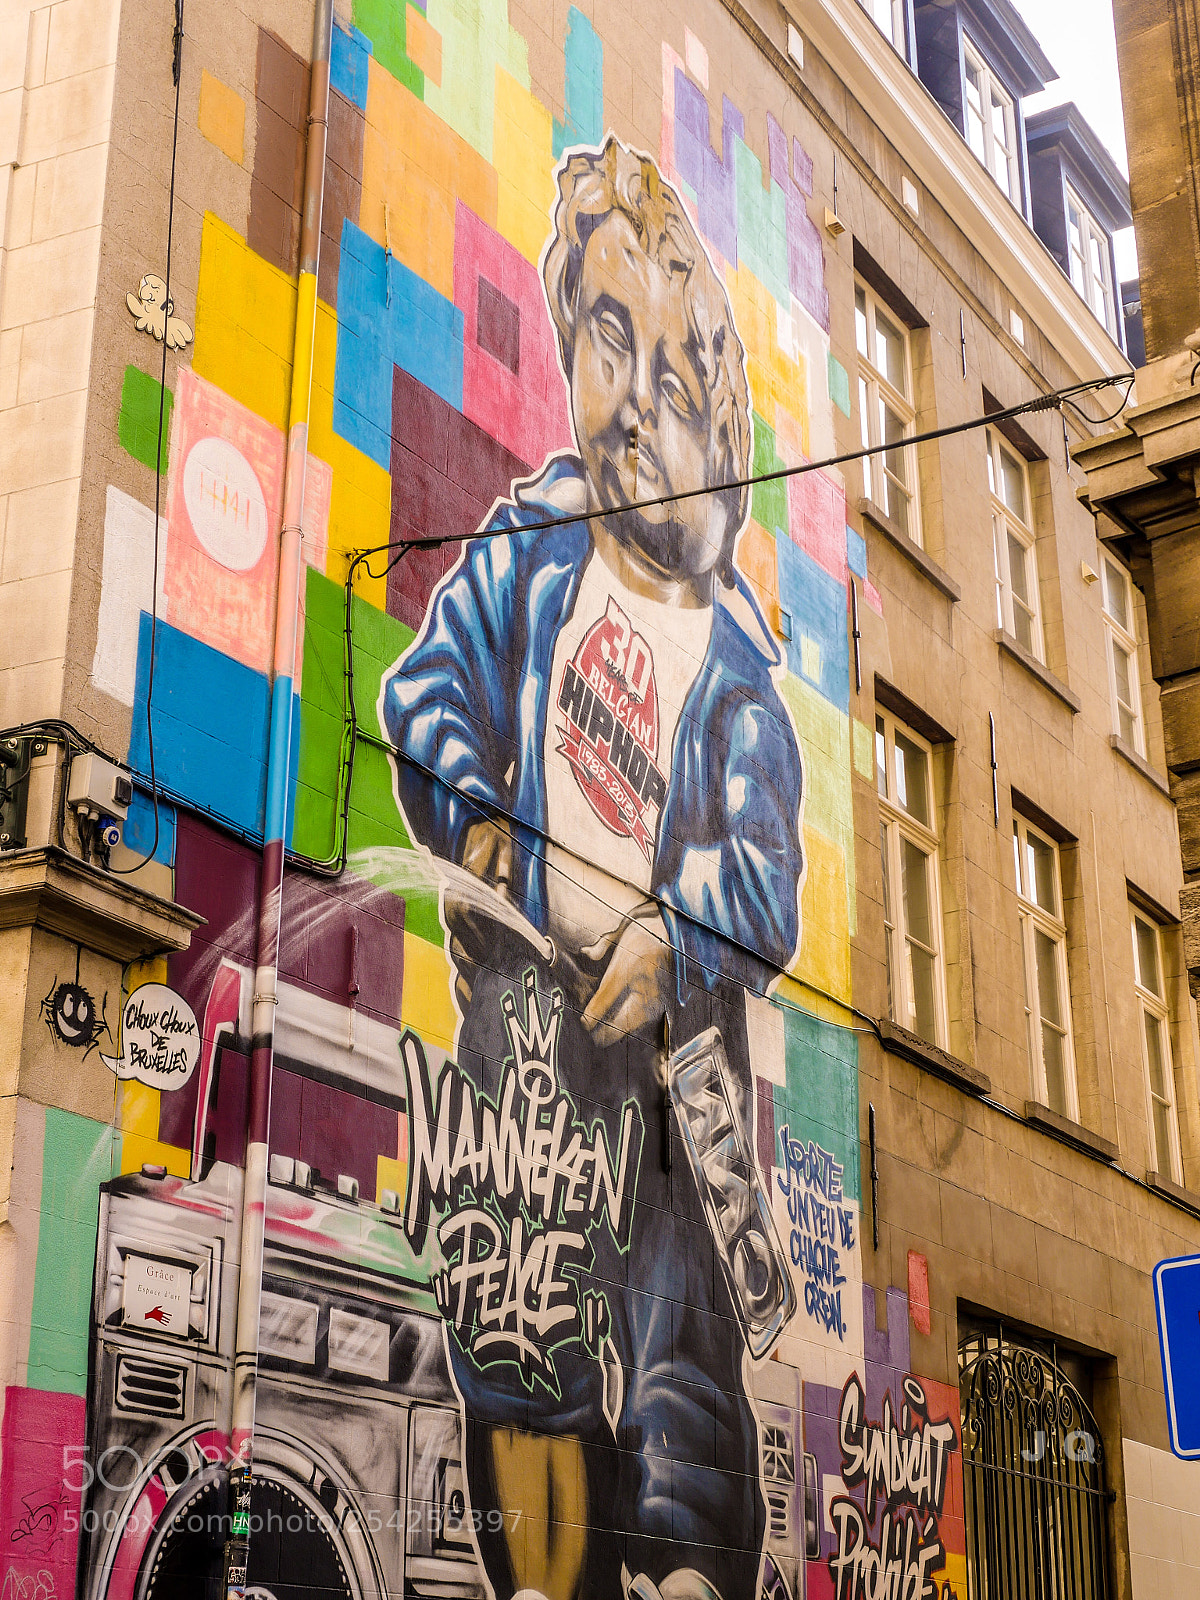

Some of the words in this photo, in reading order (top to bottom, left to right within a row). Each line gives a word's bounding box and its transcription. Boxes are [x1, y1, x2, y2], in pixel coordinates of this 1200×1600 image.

[600, 612, 651, 704] 30
[129, 1041, 187, 1074] BRUXELLES
[150, 1029, 170, 1051] DE
[787, 1188, 811, 1233] UN
[809, 1193, 836, 1245] PEU
[837, 1205, 855, 1251] DE
[789, 1228, 847, 1288] CHAQUE
[137, 1284, 161, 1297] Espace
